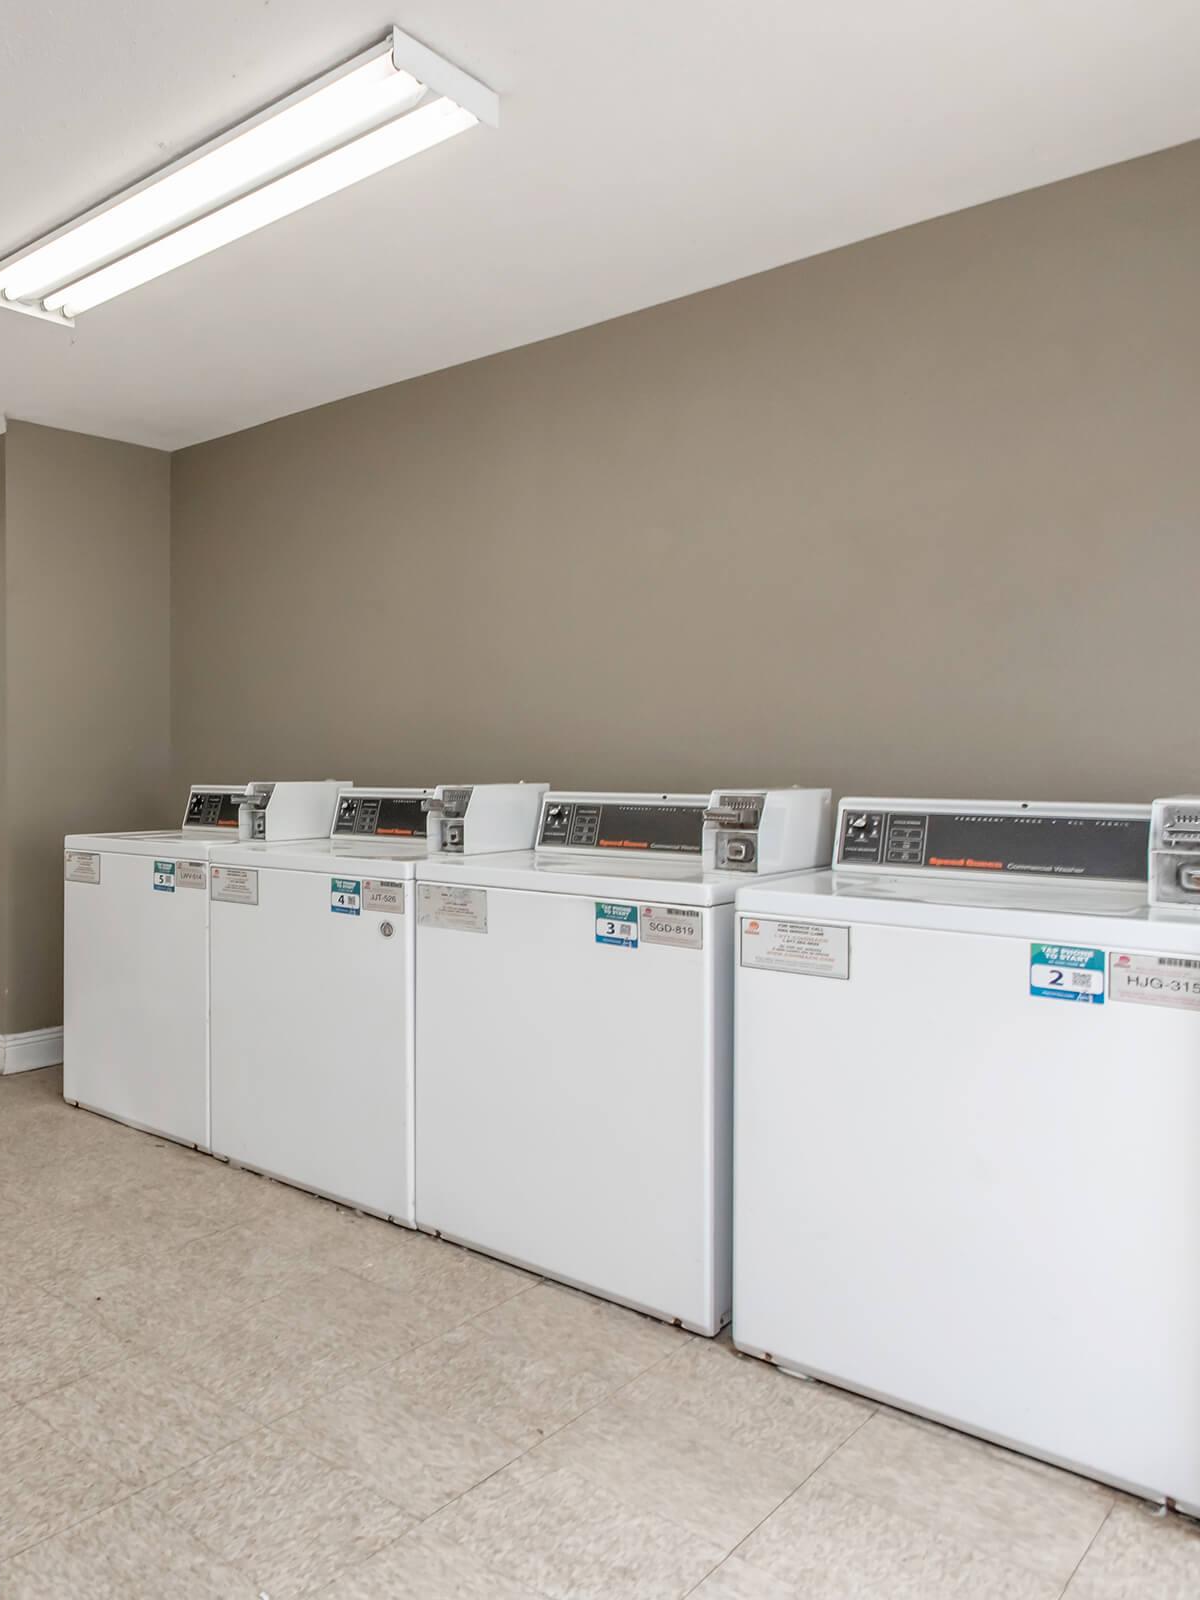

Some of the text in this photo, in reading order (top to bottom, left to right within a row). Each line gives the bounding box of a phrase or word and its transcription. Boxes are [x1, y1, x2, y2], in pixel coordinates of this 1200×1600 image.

[1007, 862, 1052, 872] Commercial
[159, 875, 164, 884] 5
[337, 895, 345, 905] 4
[606, 922, 615, 935] 3
[649, 922, 694, 936] SGD-819
[1049, 970, 1064, 986] 2
[1127, 975, 1200, 994] HJG-315
